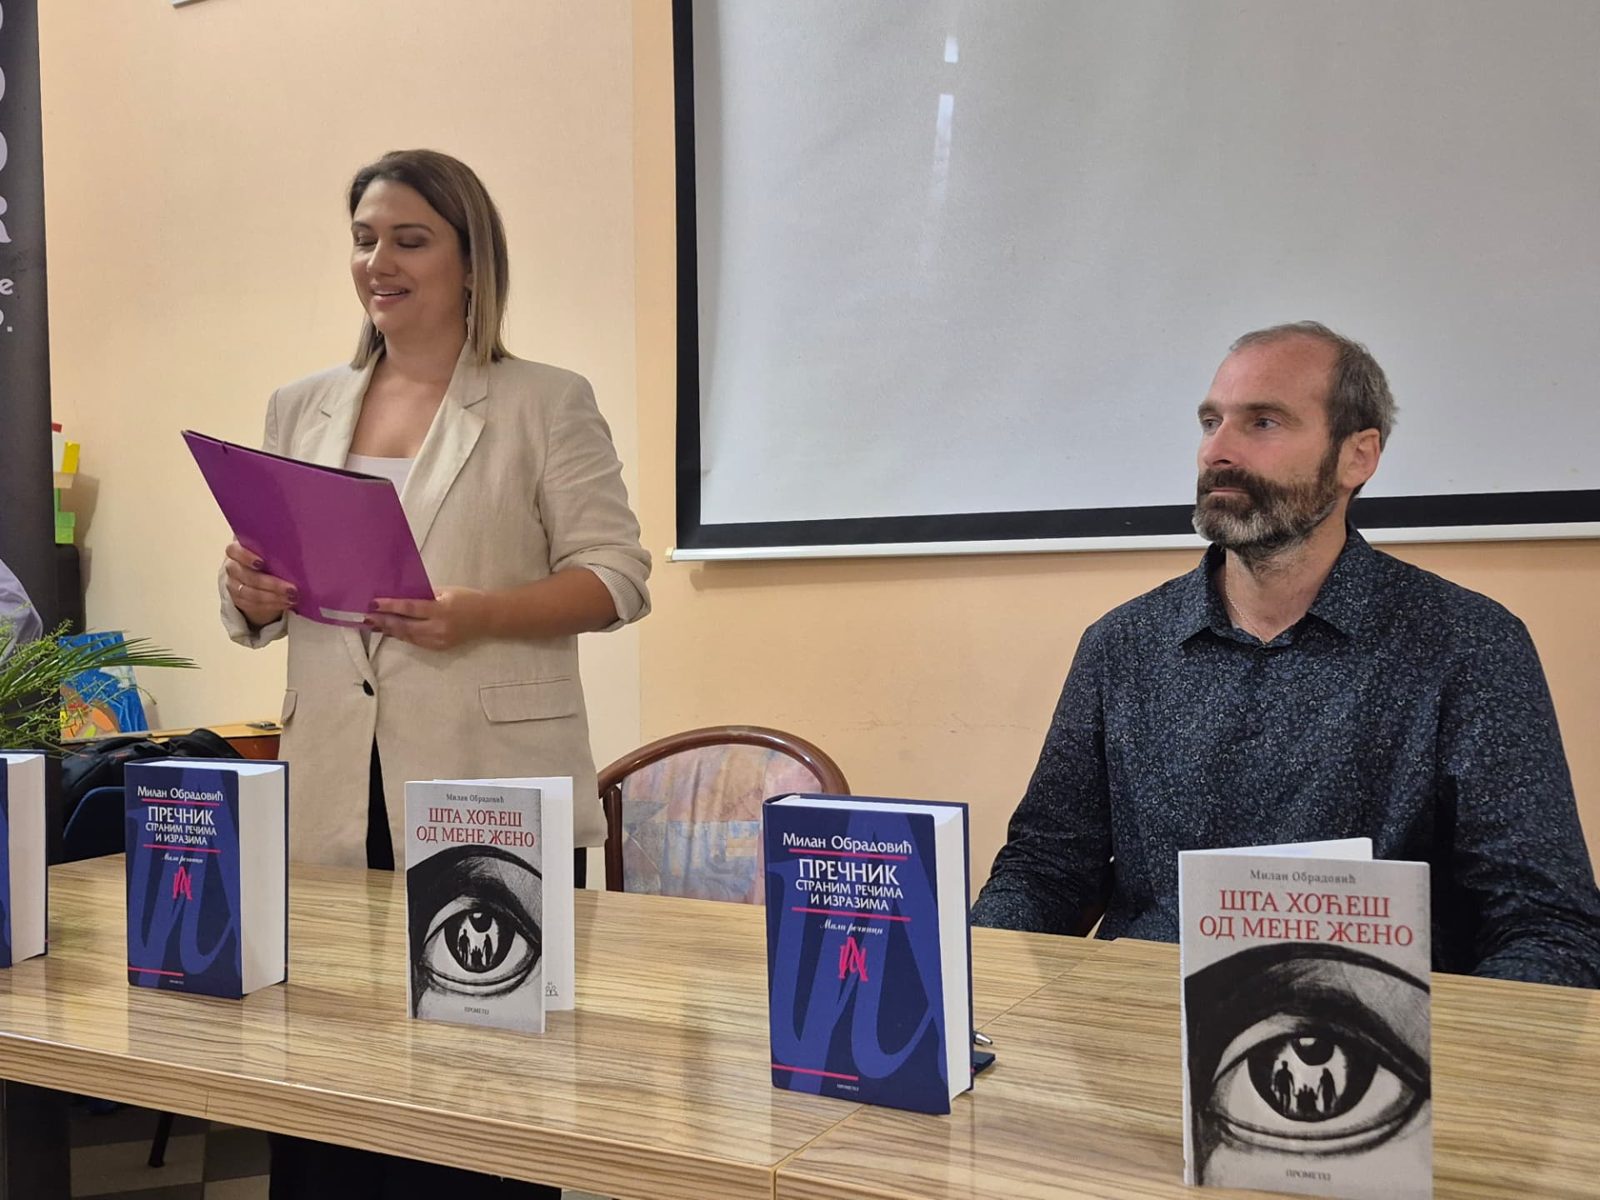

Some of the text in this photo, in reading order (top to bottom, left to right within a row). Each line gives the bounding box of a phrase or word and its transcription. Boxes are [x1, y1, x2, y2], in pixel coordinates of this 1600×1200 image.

[137, 785, 224, 802] Милан Обрадовић
[147, 806, 215, 826] ПРЕЧНИК
[428, 807, 523, 828] ШТА ХОЋЕШ
[145, 822, 217, 836] СТРАНИМ РЕЧИМА
[155, 833, 208, 846] И ИЗРАЗИМА
[416, 825, 535, 848] ОД МЕНЕ ЖЕНО
[782, 832, 913, 855] Милан Обрадовић
[798, 858, 900, 886] ПРЕЧНИК
[1250, 869, 1357, 885] Милан Обрадовић
[795, 879, 904, 900] СТРАНИМ РЕЧИМА
[810, 893, 890, 912] И ИЗРАЗИМА
[1219, 888, 1391, 919] ШТА ХОЋЕШ
[1199, 915, 1414, 947] ОД МЕНЕ ЖЕНО
